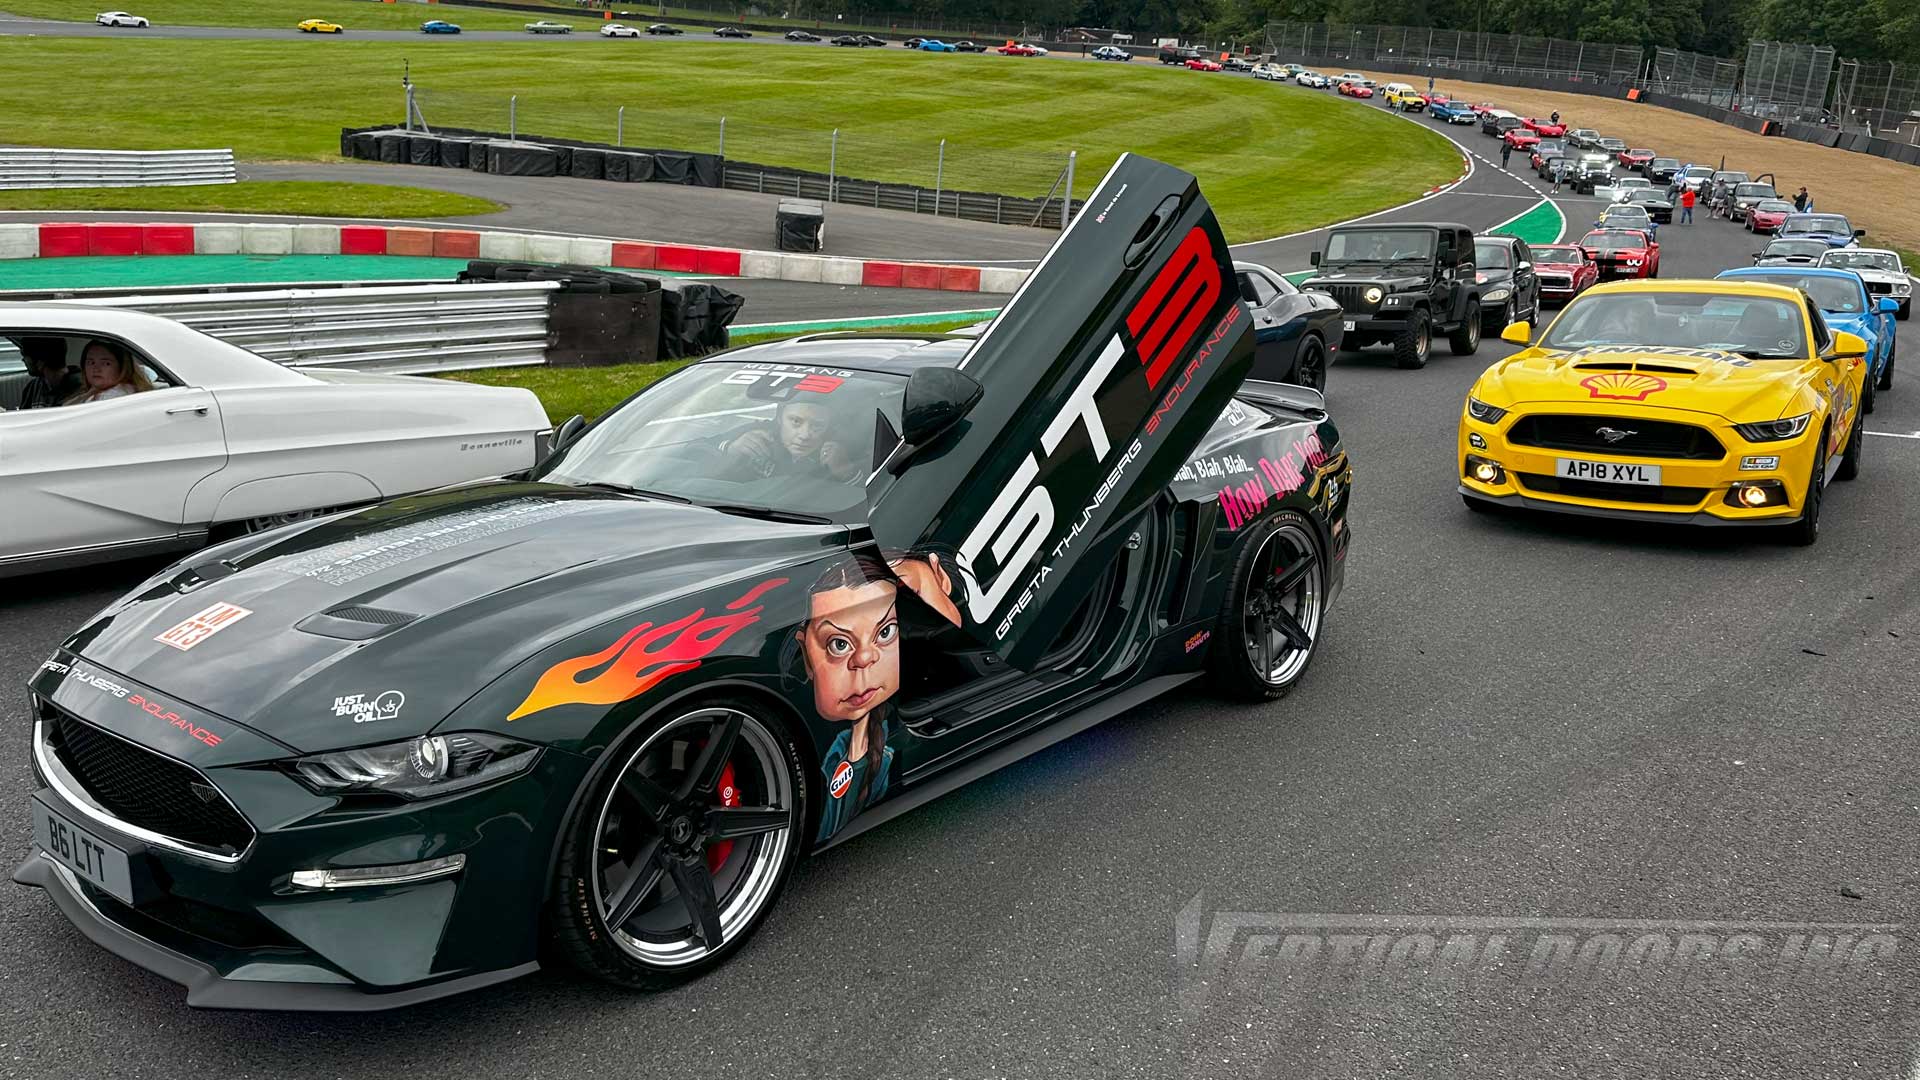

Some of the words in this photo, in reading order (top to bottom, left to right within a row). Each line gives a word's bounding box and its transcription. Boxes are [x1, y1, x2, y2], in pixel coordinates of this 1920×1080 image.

[721, 370, 846, 394] GT3
[743, 363, 855, 378] MUSTANG
[955, 226, 1222, 624] GT3
[460, 438, 523, 451] Bonneville
[1194, 458, 1226, 479] Blah,
[1567, 460, 1607, 479] AP18
[1612, 465, 1649, 482] XYL
[995, 565, 1053, 640] GRETA
[1052, 438, 1143, 558] THUNBERG
[163, 621, 213, 646] GT3
[41, 660, 71, 676] GRETA
[67, 667, 131, 699] THUNBERG
[331, 693, 365, 711] JUST
[336, 701, 375, 716] BURN
[354, 711, 377, 723] OIL
[831, 767, 853, 792] Gulf
[48, 815, 70, 860] B6
[72, 831, 105, 882] LTT
